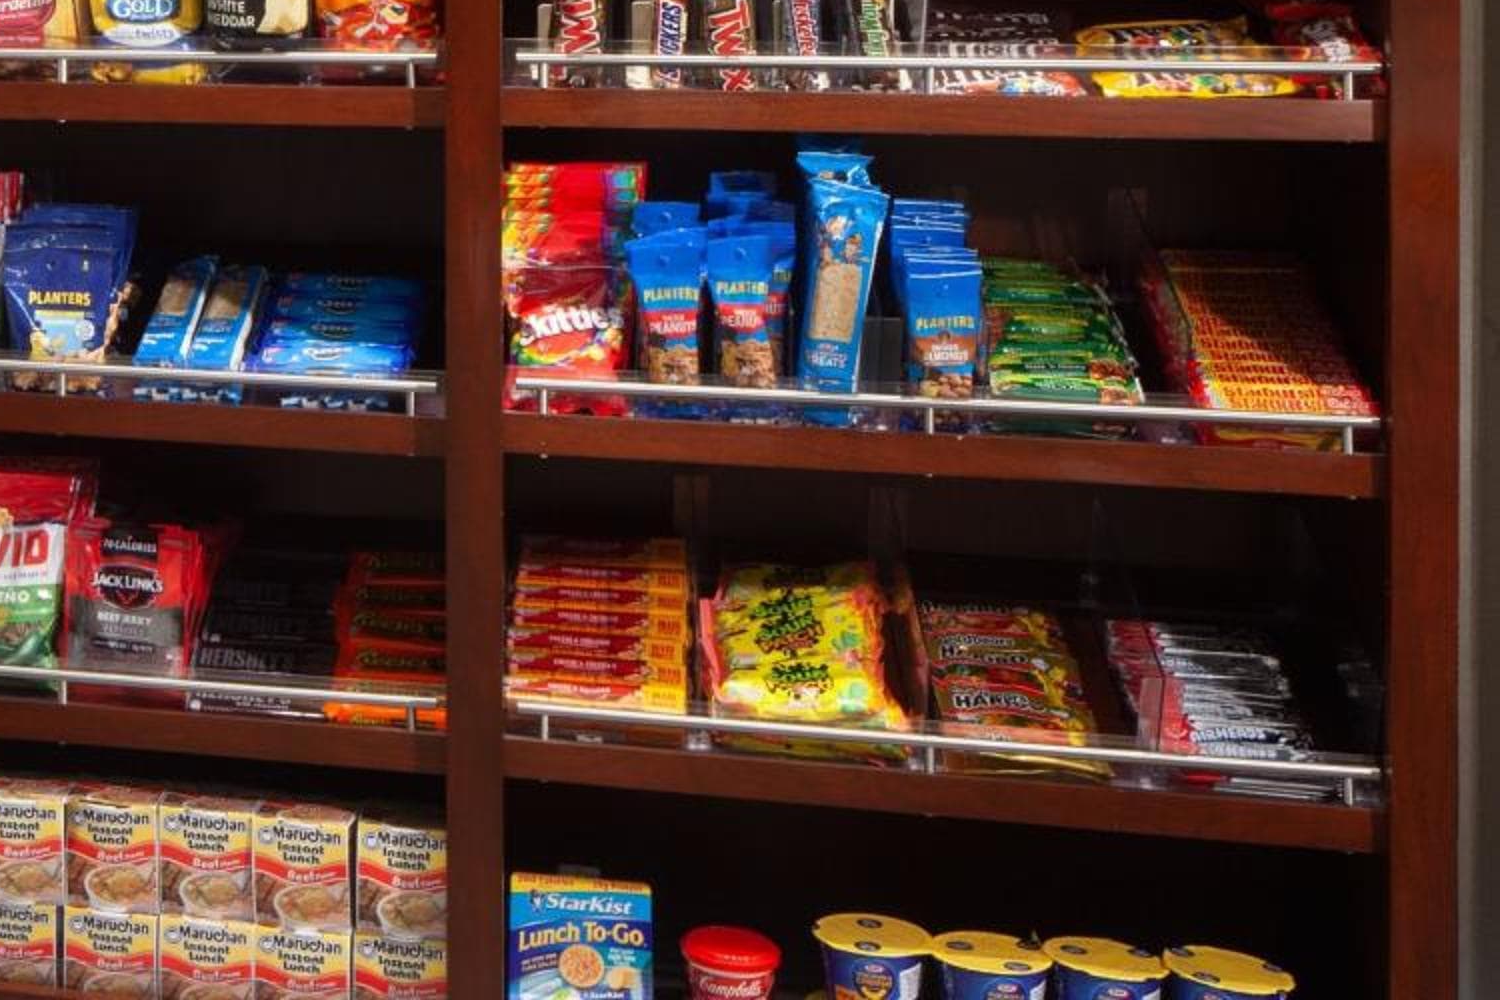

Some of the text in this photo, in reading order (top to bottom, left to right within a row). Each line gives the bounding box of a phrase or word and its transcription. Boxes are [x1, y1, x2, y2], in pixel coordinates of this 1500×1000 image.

[29, 290, 91, 306] PLANTERS
[916, 316, 975, 330] PLANTERS
[92, 572, 123, 588] JACK
[83, 809, 150, 826] Maruchan
[179, 814, 246, 832] Maruchan
[273, 826, 341, 845] Maruchan
[546, 893, 632, 915] StarKist
[83, 916, 149, 935] Maruchan
[179, 925, 247, 944] Maruchan
[273, 936, 341, 955] Maruchan
[519, 921, 645, 952] Lunch To-Go
